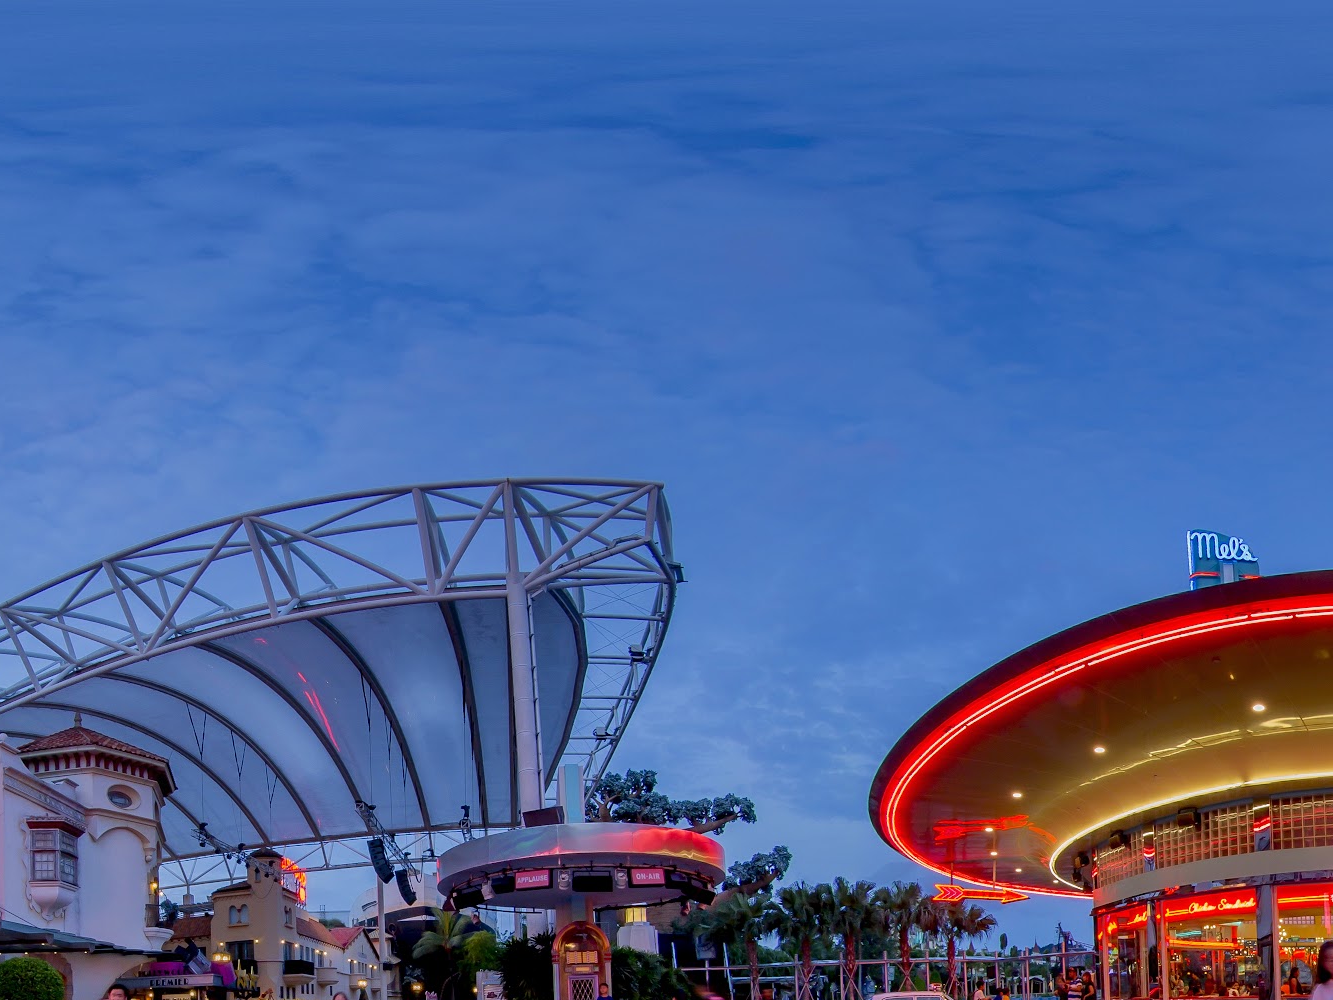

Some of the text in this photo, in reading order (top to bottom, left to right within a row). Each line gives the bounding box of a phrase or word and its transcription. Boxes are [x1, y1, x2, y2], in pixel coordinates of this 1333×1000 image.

[1191, 532, 1259, 561] Mel's
[517, 875, 548, 883] APPLAUSE
[1188, 898, 1256, 913] Chicken Sandwich
[150, 978, 189, 987] PREMIER
